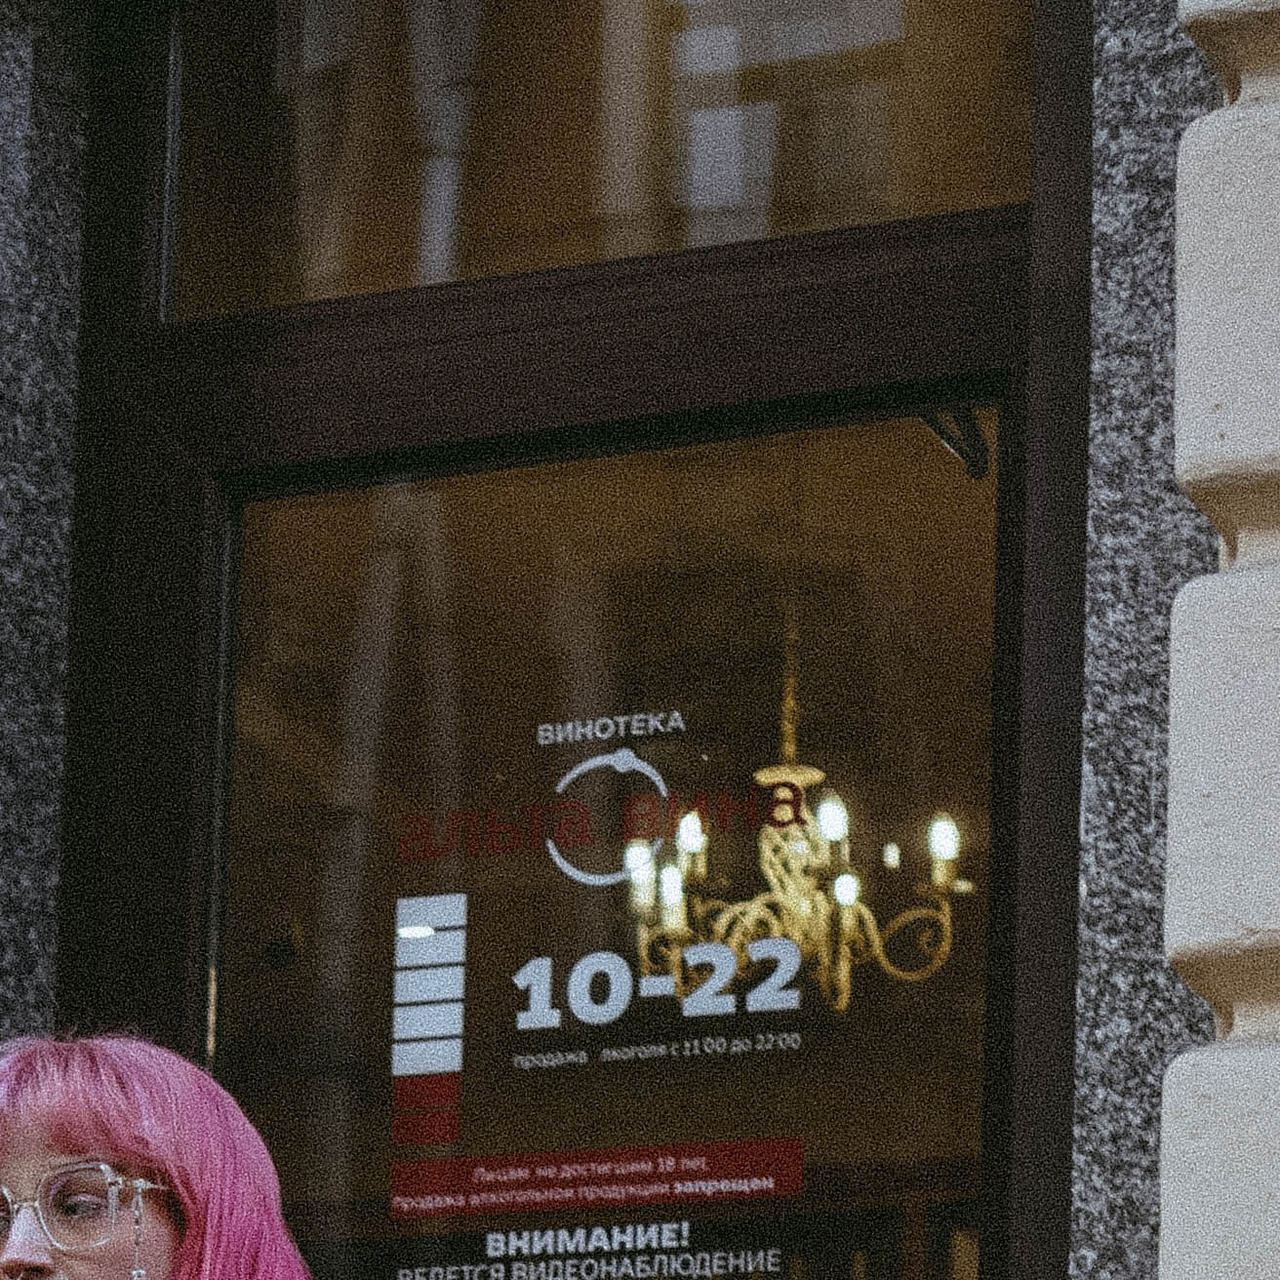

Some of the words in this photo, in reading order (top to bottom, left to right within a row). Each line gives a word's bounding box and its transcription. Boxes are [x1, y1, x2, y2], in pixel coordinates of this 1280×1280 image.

[536, 710, 685, 745] ВИНОТЕКА
[512, 937, 803, 1030] 10-22
[486, 1222, 690, 1258] ВНИМАНИЕ!
